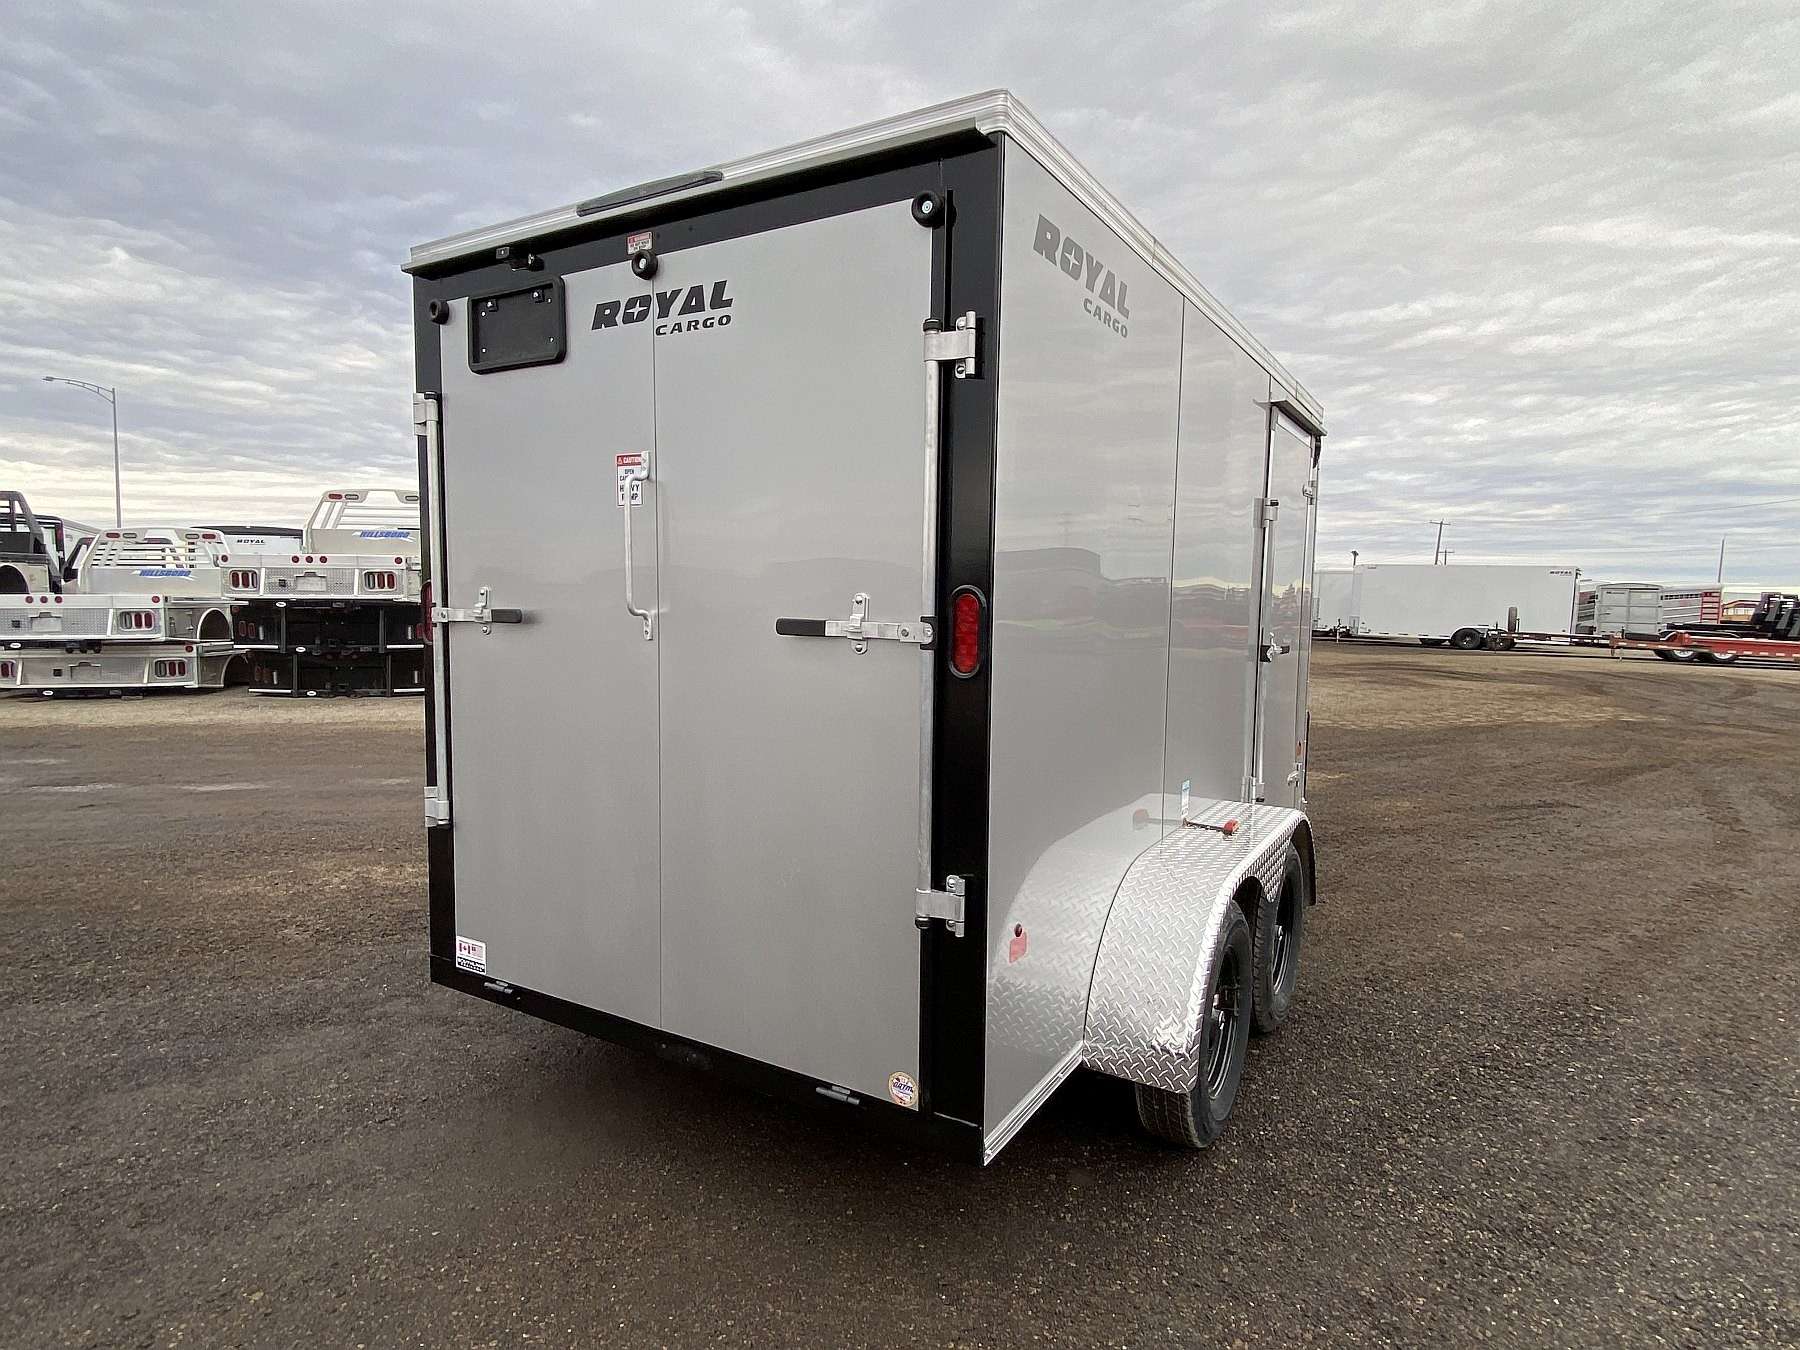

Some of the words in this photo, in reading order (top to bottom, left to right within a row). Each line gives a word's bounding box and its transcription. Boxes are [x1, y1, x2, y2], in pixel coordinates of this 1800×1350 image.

[1033, 214, 1130, 319] ROYAL
[591, 280, 734, 330] ROYAL
[655, 314, 732, 336] CARGO
[1083, 298, 1128, 338] CARGO
[620, 484, 640, 492] HVY
